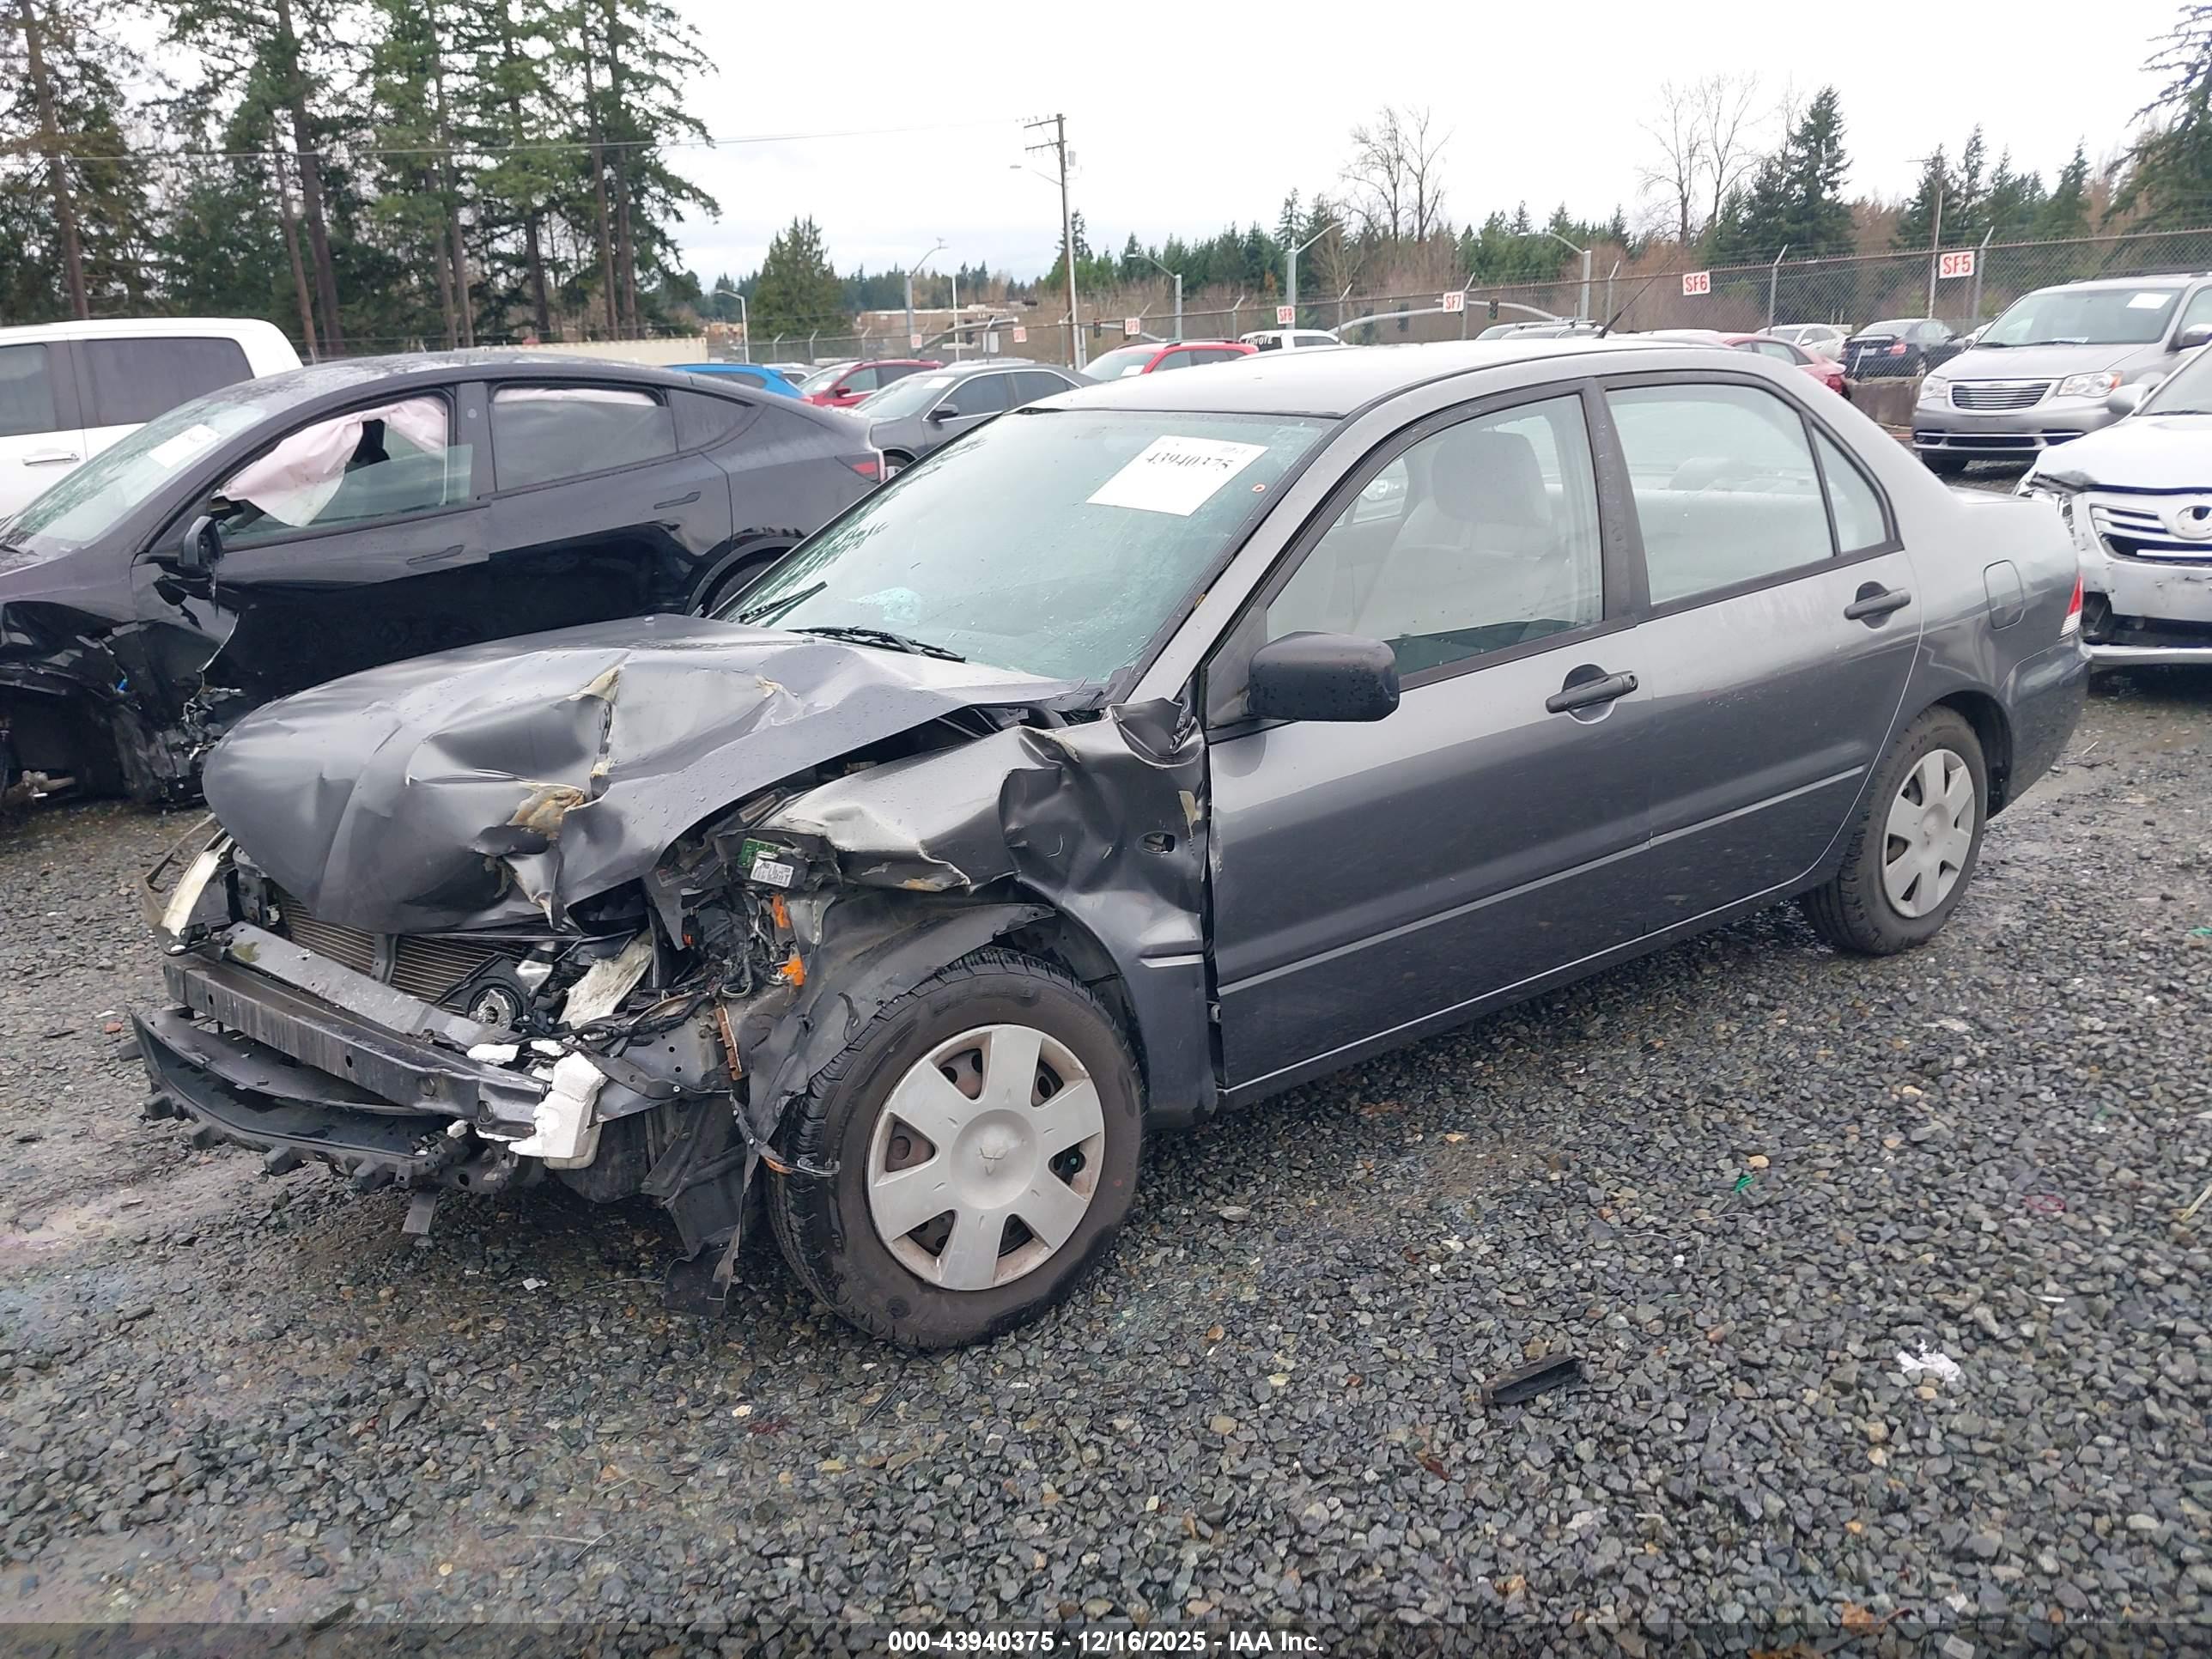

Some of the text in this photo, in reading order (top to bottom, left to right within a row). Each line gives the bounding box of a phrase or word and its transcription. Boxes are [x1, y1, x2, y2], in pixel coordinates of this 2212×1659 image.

[1943, 254, 1972, 275] SF5
[1685, 275, 1708, 292] SF6
[1445, 295, 1462, 310] SF7
[1278, 307, 1293, 322] SF8
